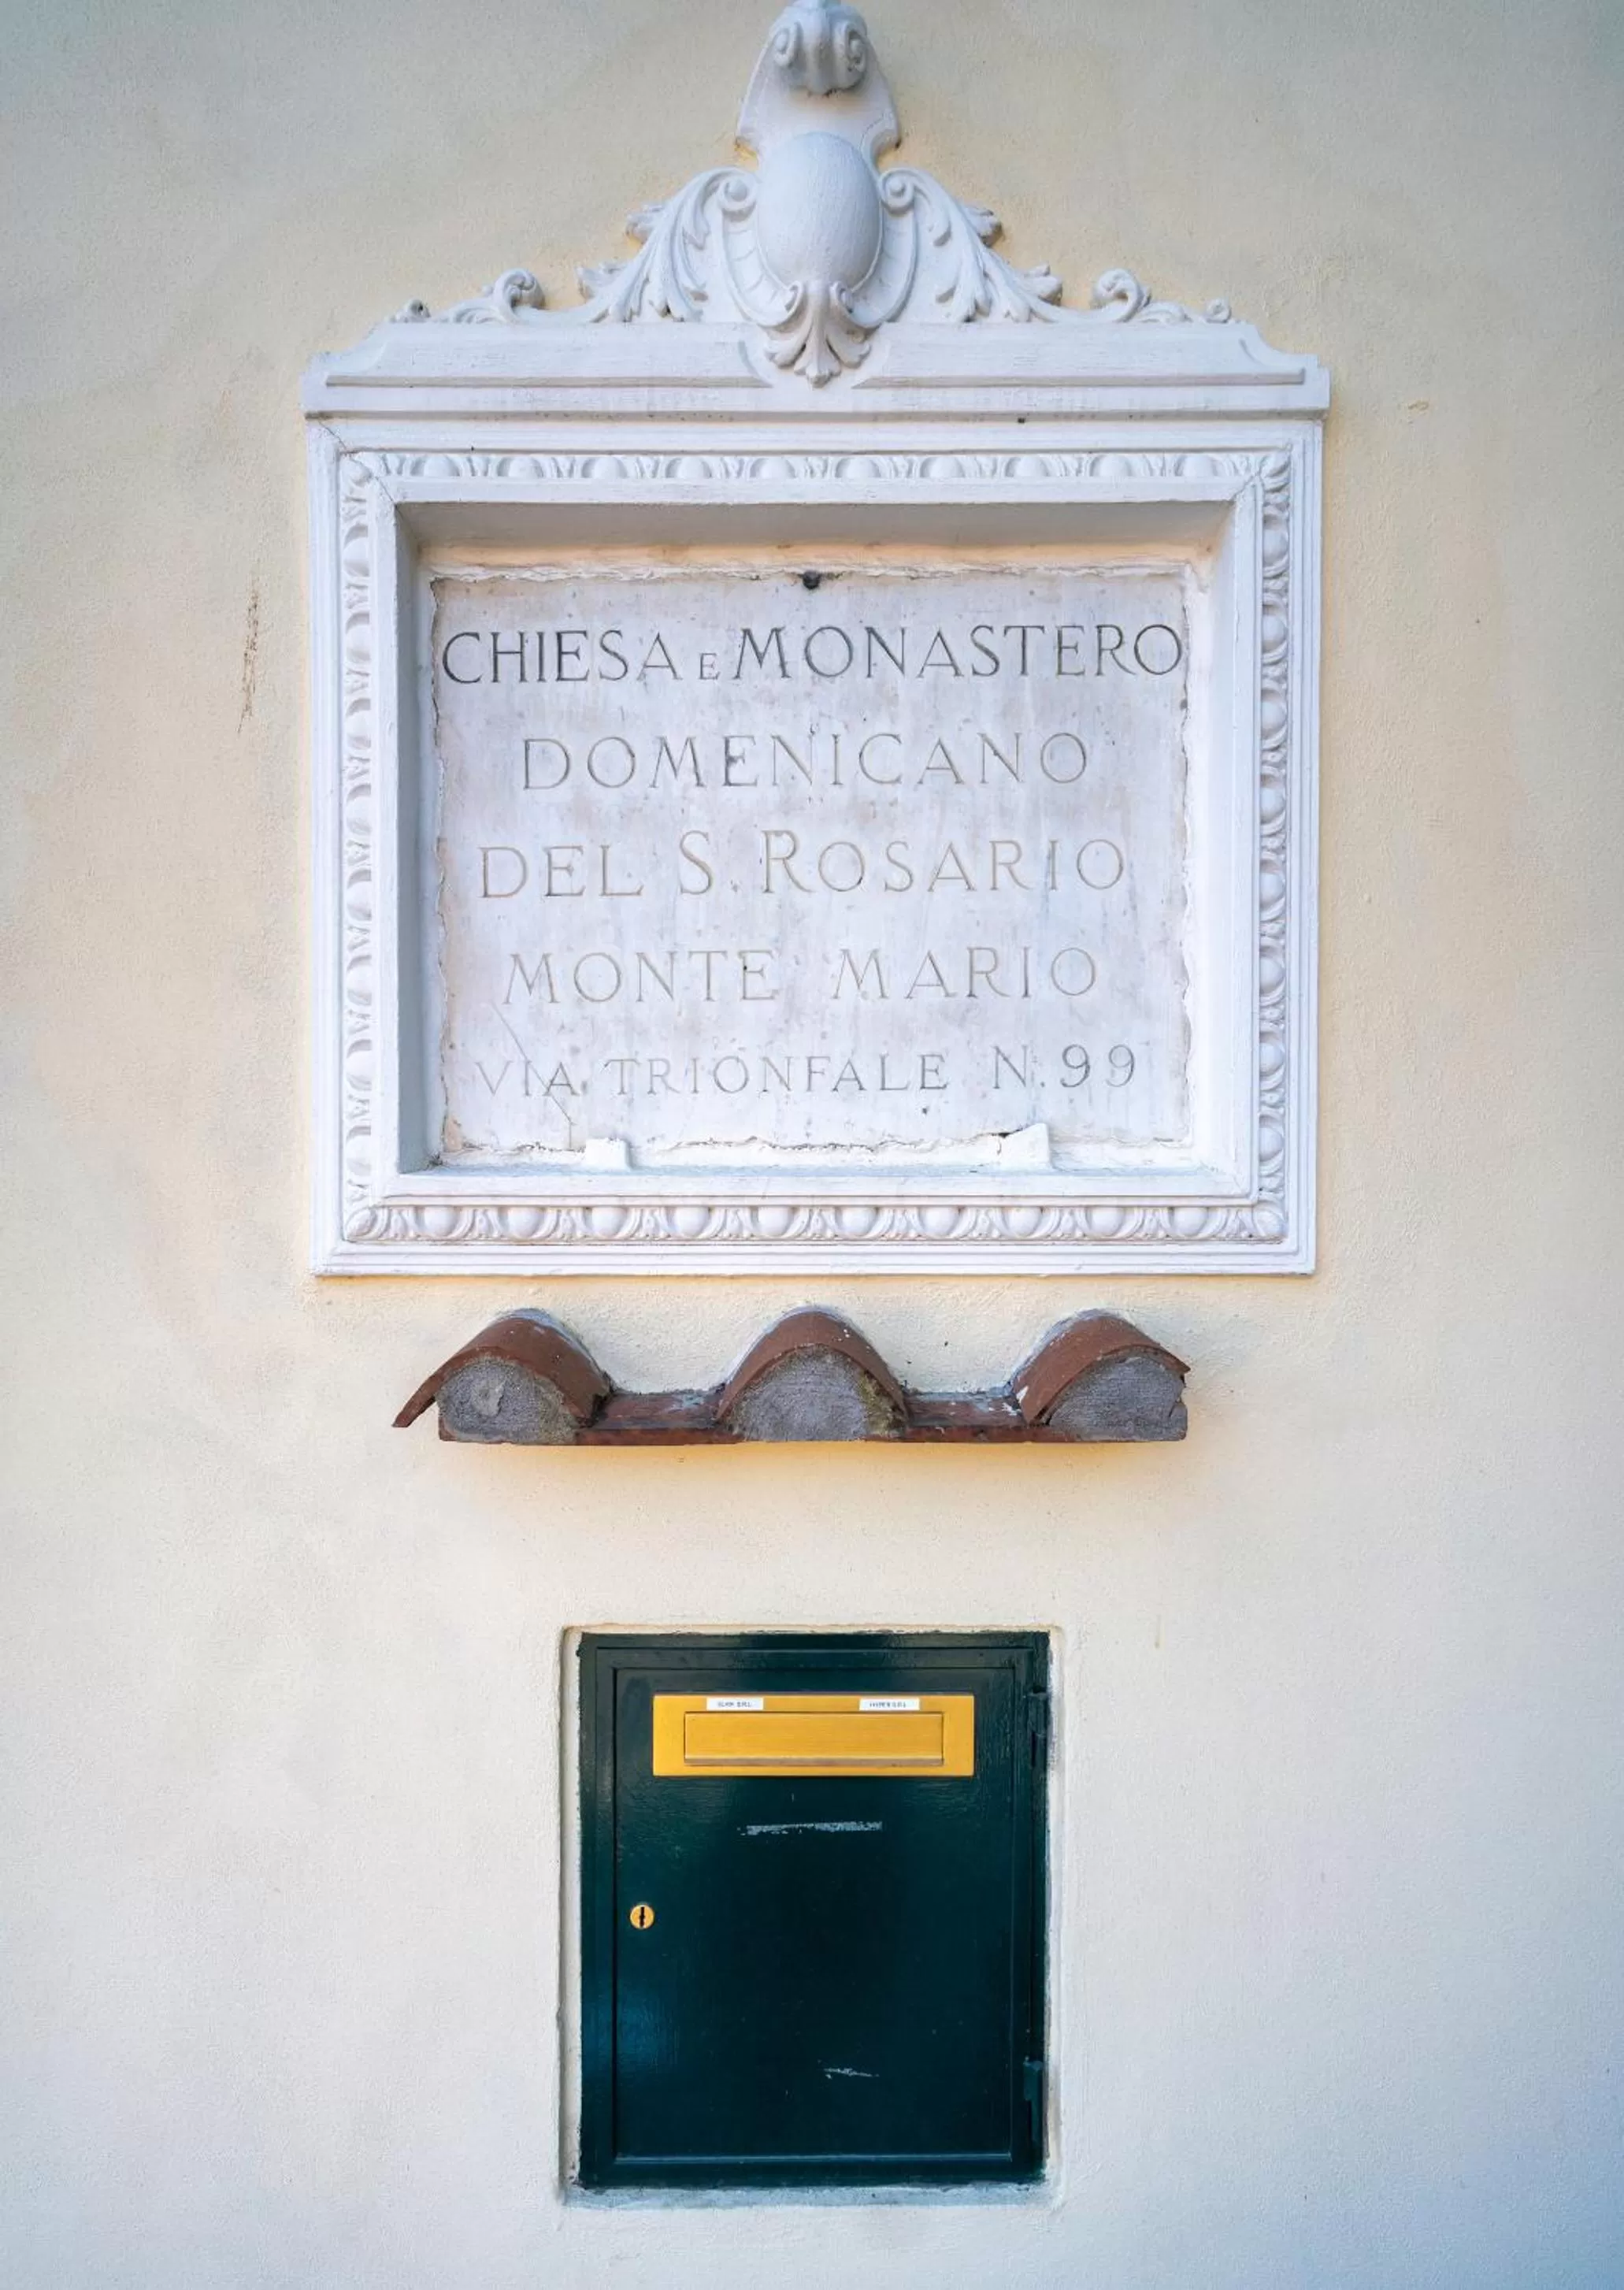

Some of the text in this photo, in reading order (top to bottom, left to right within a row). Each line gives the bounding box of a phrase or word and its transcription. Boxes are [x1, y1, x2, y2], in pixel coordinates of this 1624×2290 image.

[442, 624, 1182, 684] CHIESA E MONASTERO
[523, 733, 1087, 790] DOMENICANO
[479, 844, 644, 898] DEL
[761, 830, 1124, 894] ROSARIO
[502, 946, 1096, 1004] MONTE MARIO
[475, 1060, 579, 1097] VIA
[603, 1052, 948, 1096] TRIONFALE
